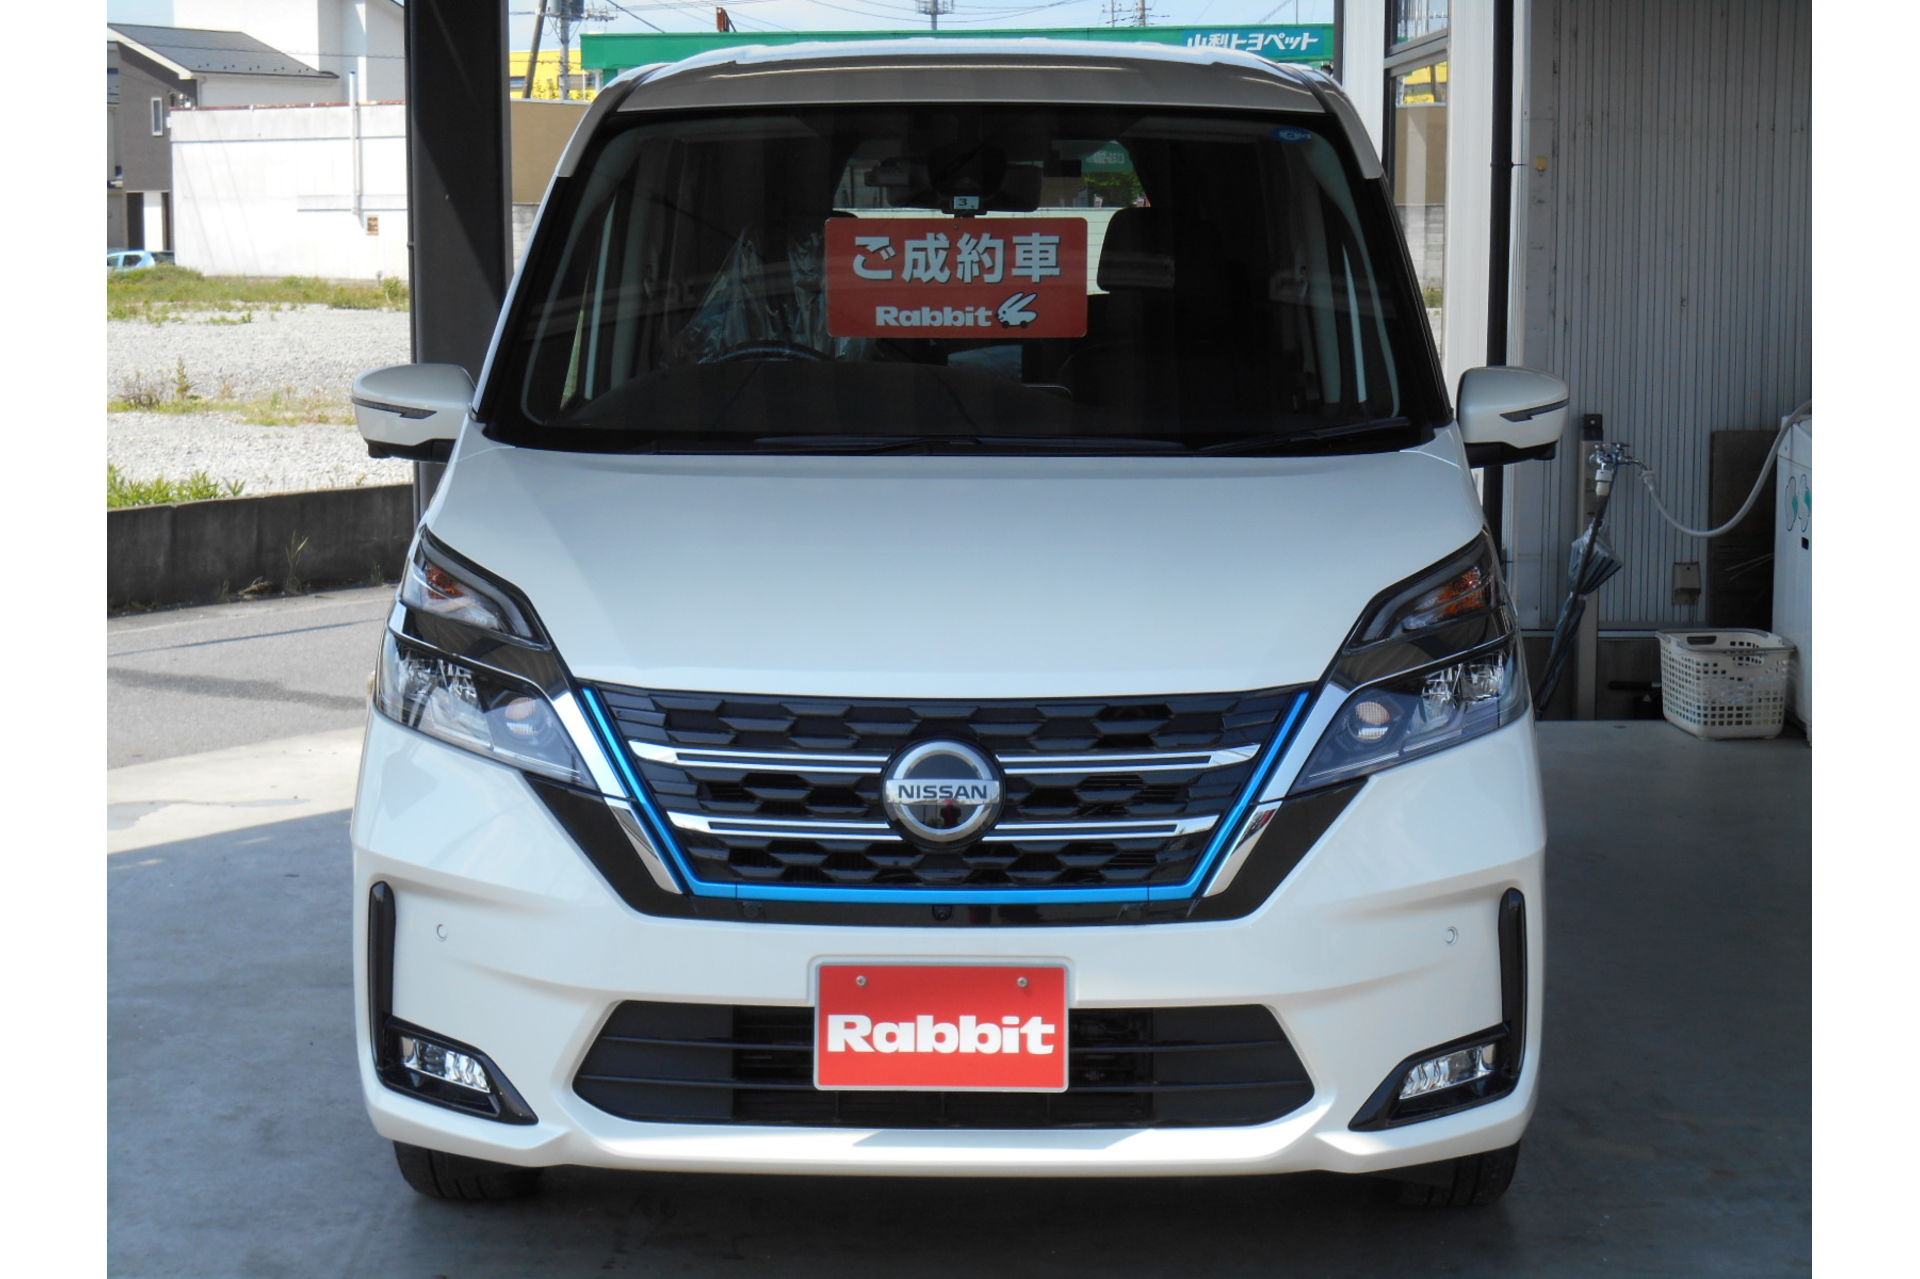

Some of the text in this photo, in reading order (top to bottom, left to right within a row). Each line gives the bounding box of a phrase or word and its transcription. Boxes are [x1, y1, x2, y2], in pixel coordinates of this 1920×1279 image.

[853, 233, 1060, 284] ご成約車
[876, 306, 992, 327] Rabbit
[898, 785, 987, 799] NISSAN
[827, 1014, 1055, 1054] Rabbit
